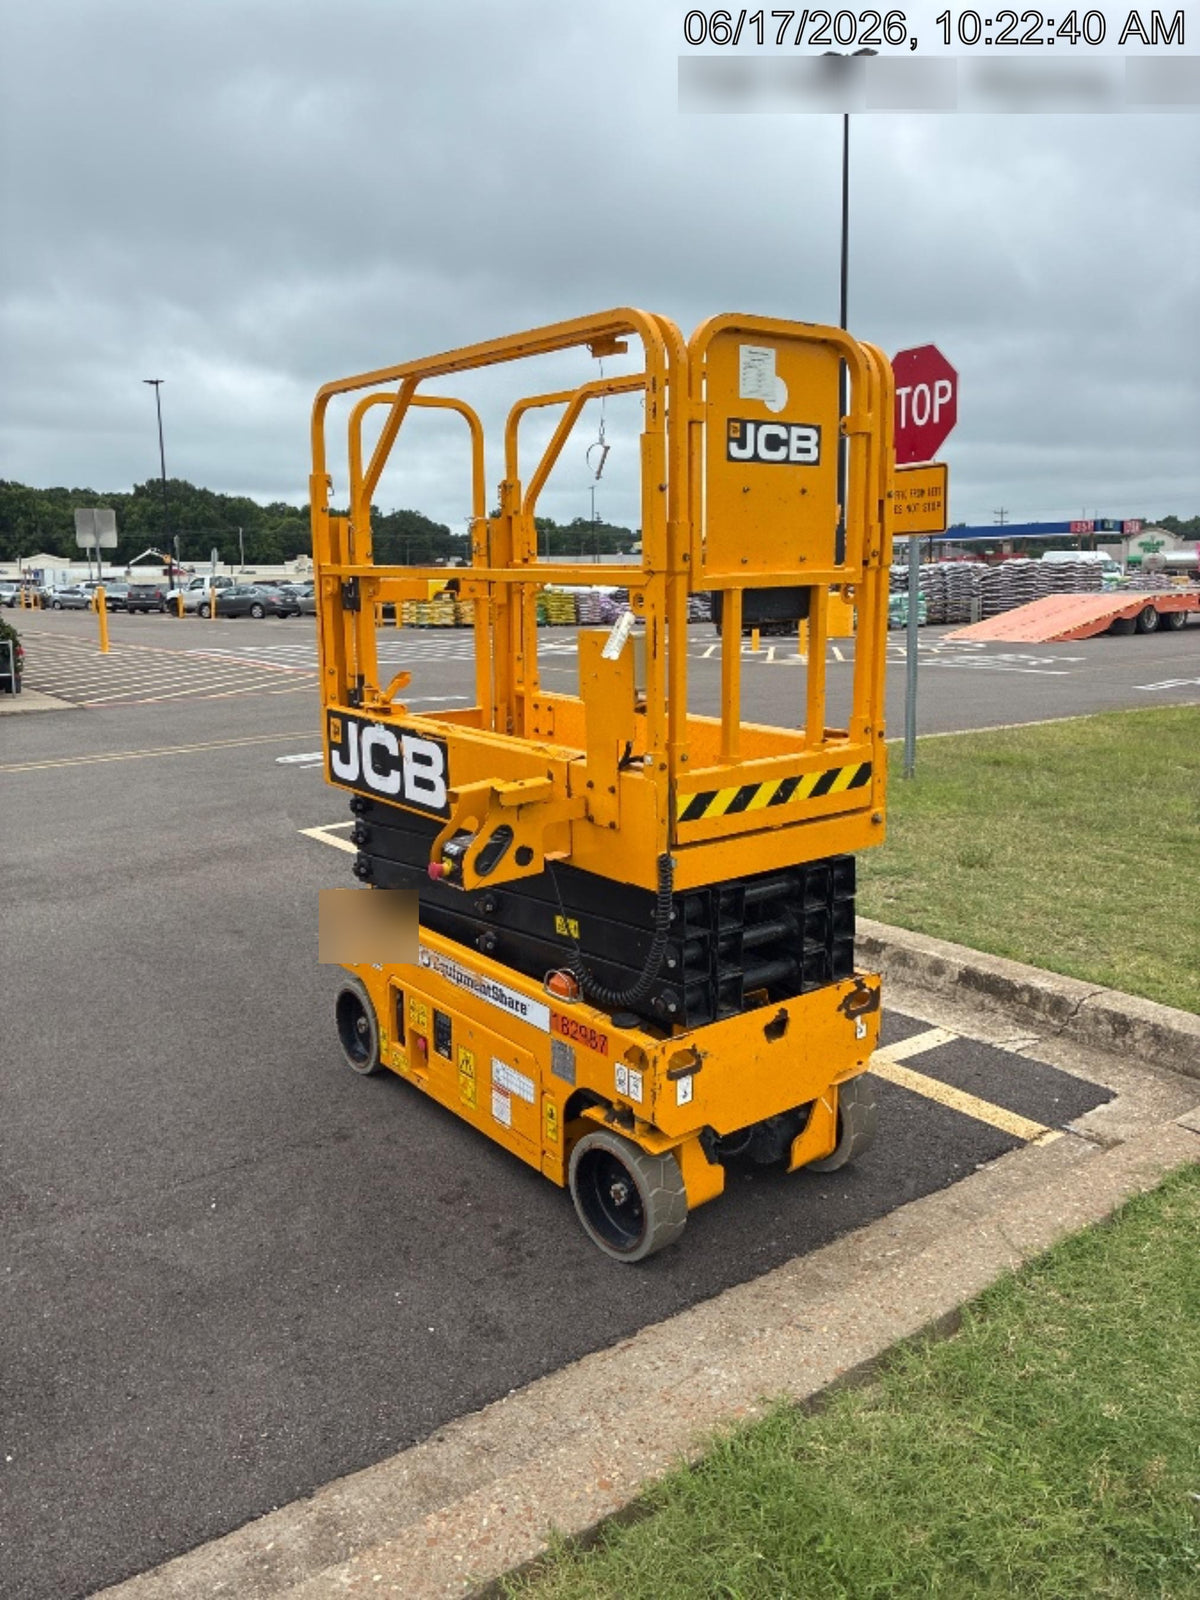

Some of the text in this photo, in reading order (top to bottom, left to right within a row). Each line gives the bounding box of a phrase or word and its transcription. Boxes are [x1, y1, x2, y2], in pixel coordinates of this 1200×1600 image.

[896, 380, 952, 429] TOP
[729, 423, 818, 462] JCB
[332, 721, 446, 809] JCB
